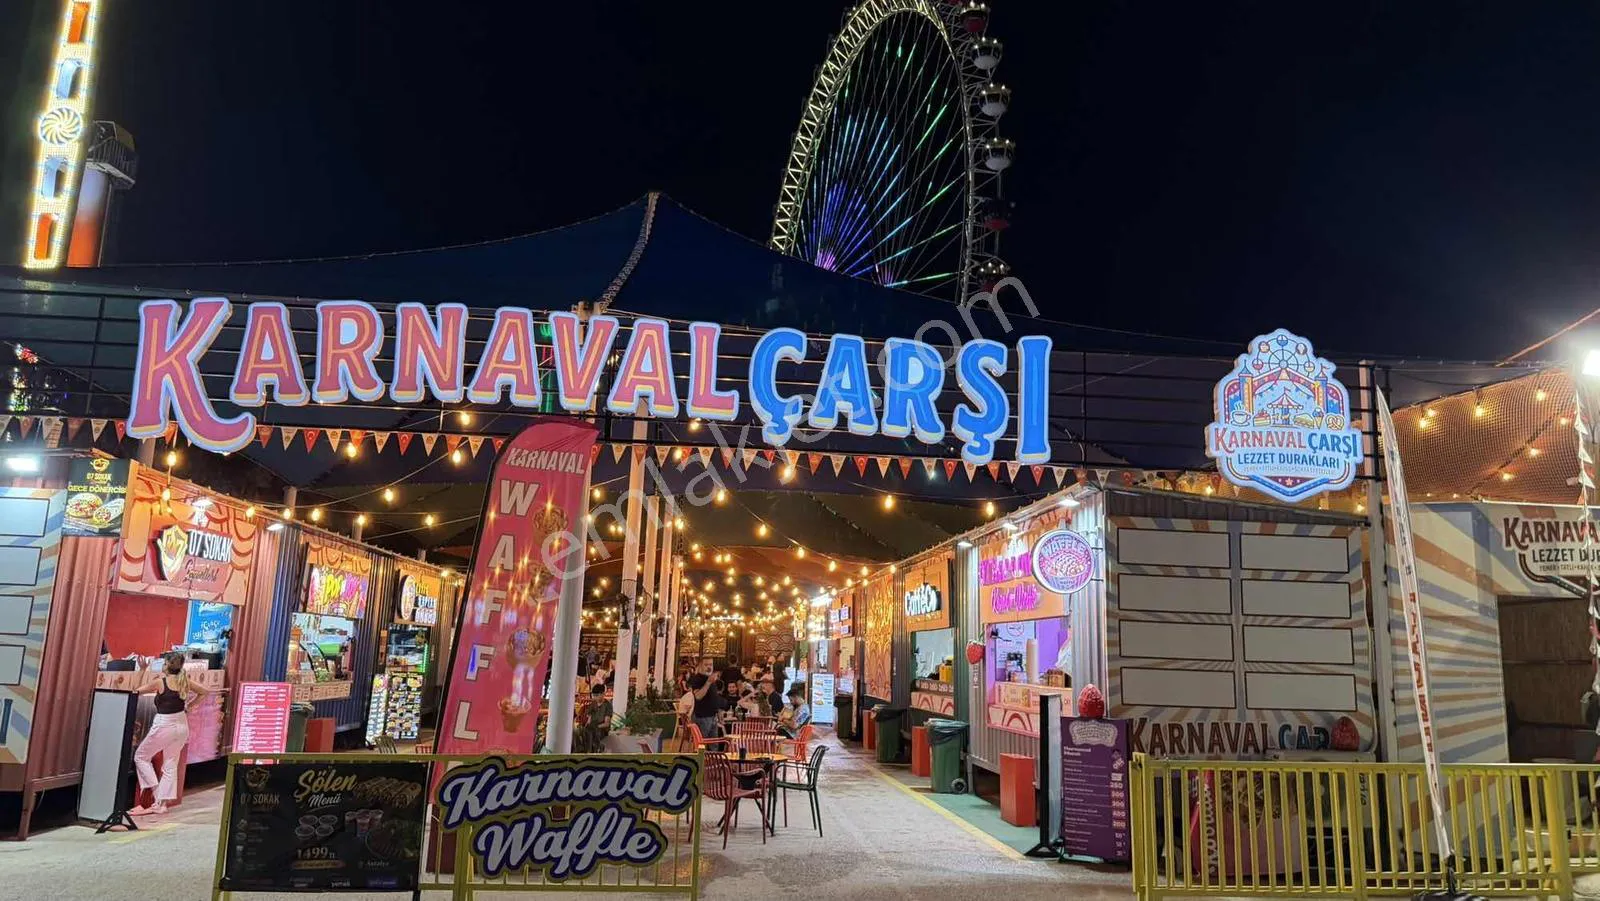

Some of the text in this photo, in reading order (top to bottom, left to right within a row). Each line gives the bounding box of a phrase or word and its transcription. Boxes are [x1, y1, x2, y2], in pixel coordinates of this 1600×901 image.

[508, 447, 586, 476] KARNAVAL
[1238, 452, 1339, 469] LEZZET DURAKLARI
[189, 530, 233, 563] 07 SOKAK
[1042, 540, 1086, 557] WAFFLE
[1532, 548, 1575, 563] LEZZET
[293, 766, 359, 803] Şölen
[253, 793, 280, 806] SOKAK
[307, 793, 343, 808] Menü
[442, 766, 690, 826] Karnaval
[478, 805, 658, 874] Waffle
[296, 847, 329, 860] 1499
